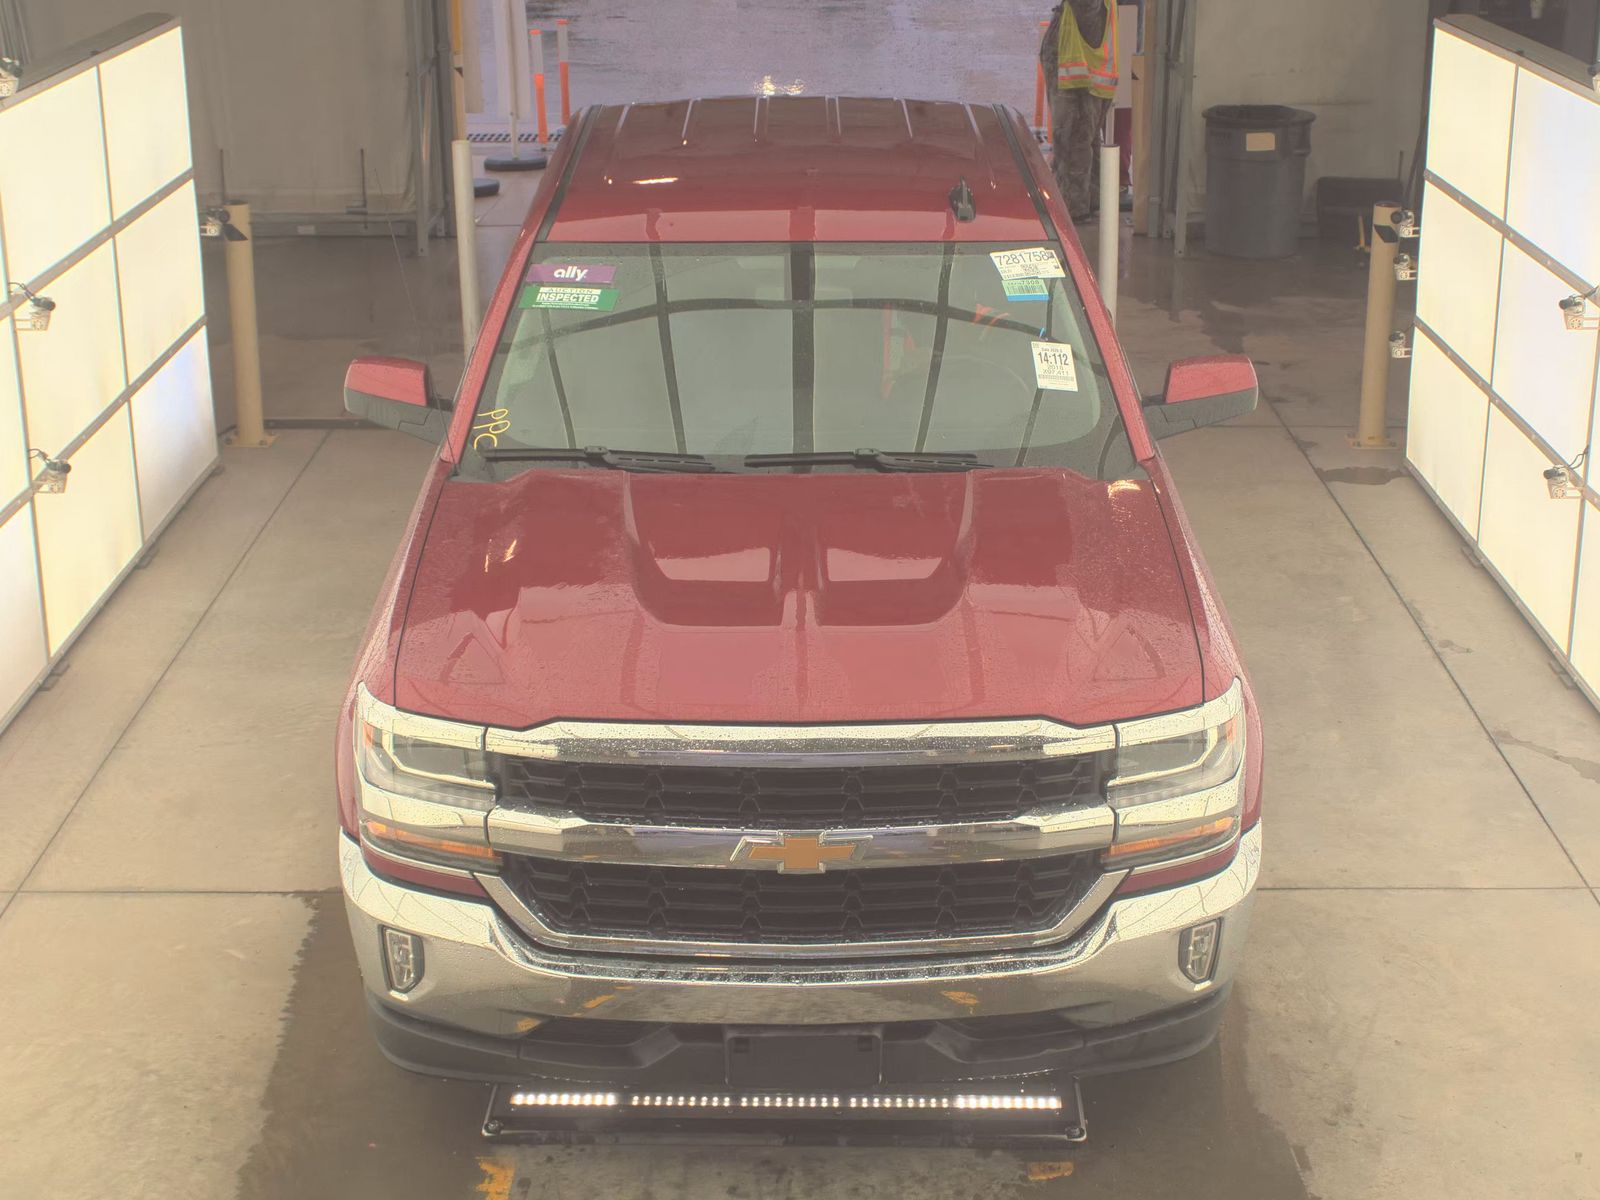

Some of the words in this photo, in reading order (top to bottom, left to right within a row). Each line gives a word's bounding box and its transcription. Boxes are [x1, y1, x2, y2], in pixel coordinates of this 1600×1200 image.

[994, 251, 1050, 265] 7281758
[553, 265, 588, 281] ally
[537, 292, 600, 303] INSPECTED
[1038, 351, 1069, 366] 14:112
